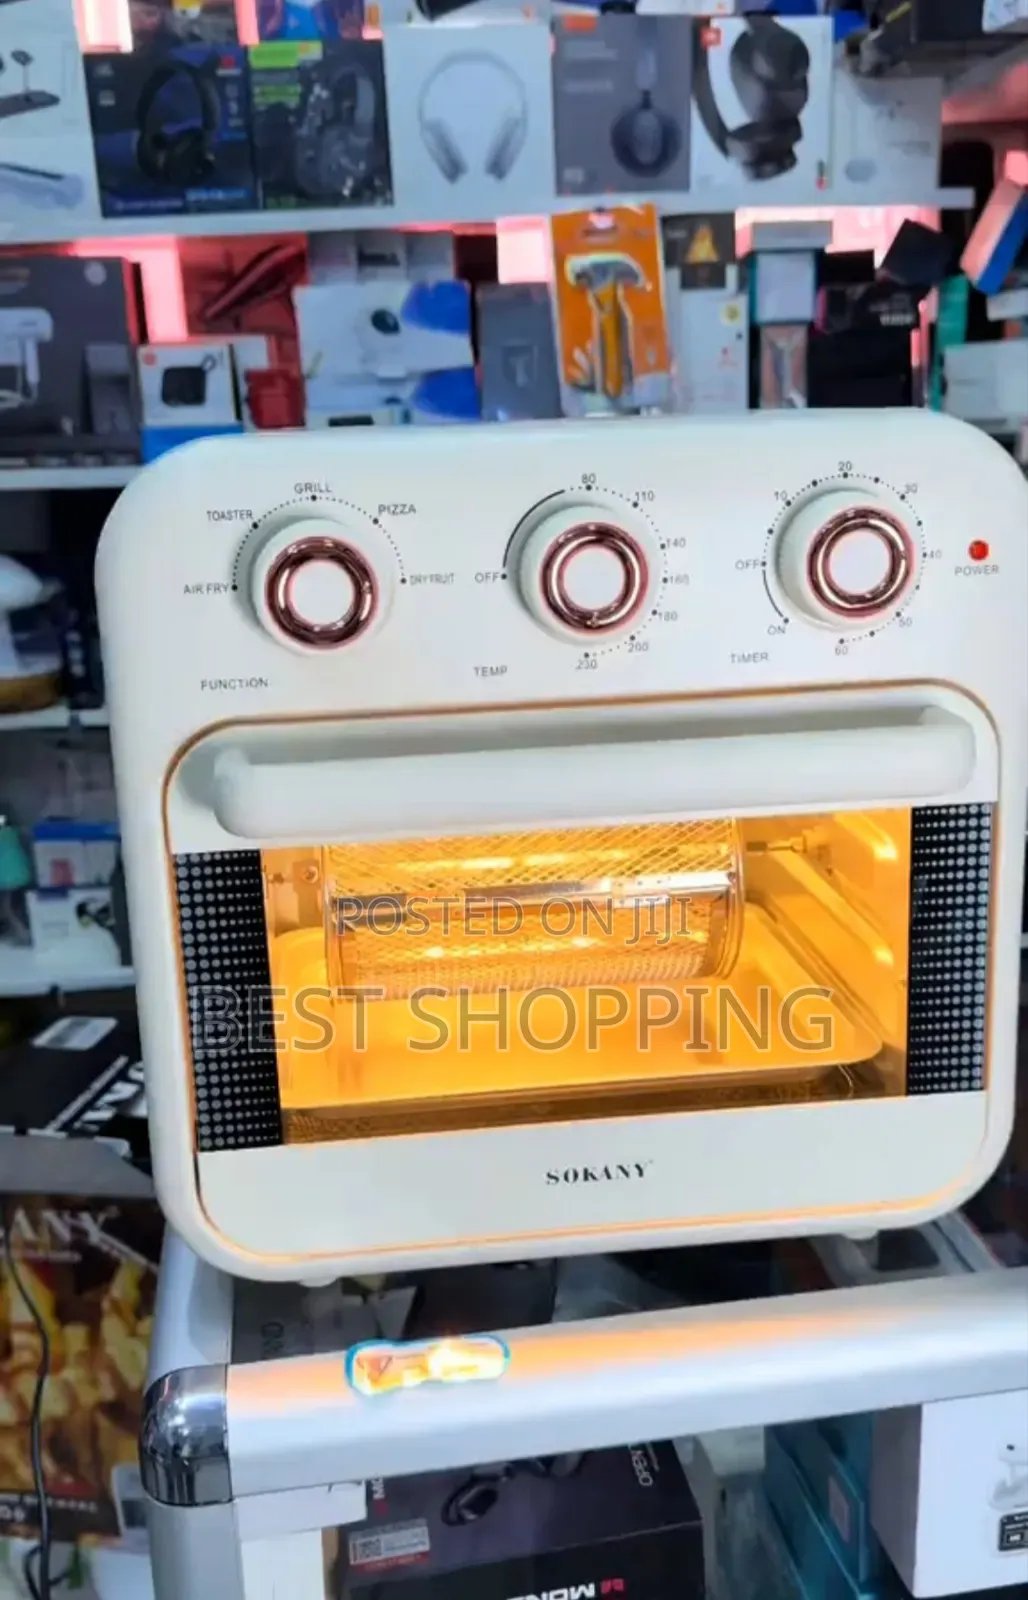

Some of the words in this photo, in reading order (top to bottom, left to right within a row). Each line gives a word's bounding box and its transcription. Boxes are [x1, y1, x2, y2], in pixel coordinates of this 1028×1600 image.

[838, 461, 853, 472] 20
[581, 473, 596, 484] 80
[294, 483, 332, 495] GRILL
[904, 483, 918, 494] 30
[634, 490, 655, 502] 110
[774, 490, 788, 501] 10
[206, 509, 253, 521] TOASTER
[378, 503, 417, 516] PIZZA
[666, 538, 686, 548] 140
[928, 550, 942, 559] 40
[735, 559, 760, 571] OFF
[954, 564, 1000, 576] POWER
[409, 574, 429, 585] DRY
[429, 573, 454, 584] FRUIT
[474, 572, 499, 583] OFF
[669, 574, 690, 585] 160
[183, 584, 205, 595] AIR
[206, 583, 229, 594] FRY
[658, 611, 679, 622] 180
[899, 617, 913, 628] 50
[767, 625, 786, 636] ON
[627, 641, 649, 652] 200
[834, 646, 849, 656] 60
[730, 652, 769, 664] TIMER
[576, 658, 598, 670] 230
[473, 665, 508, 677] TEMP
[200, 677, 269, 691] FUNCTION
[546, 1162, 644, 1185] SOKANY
